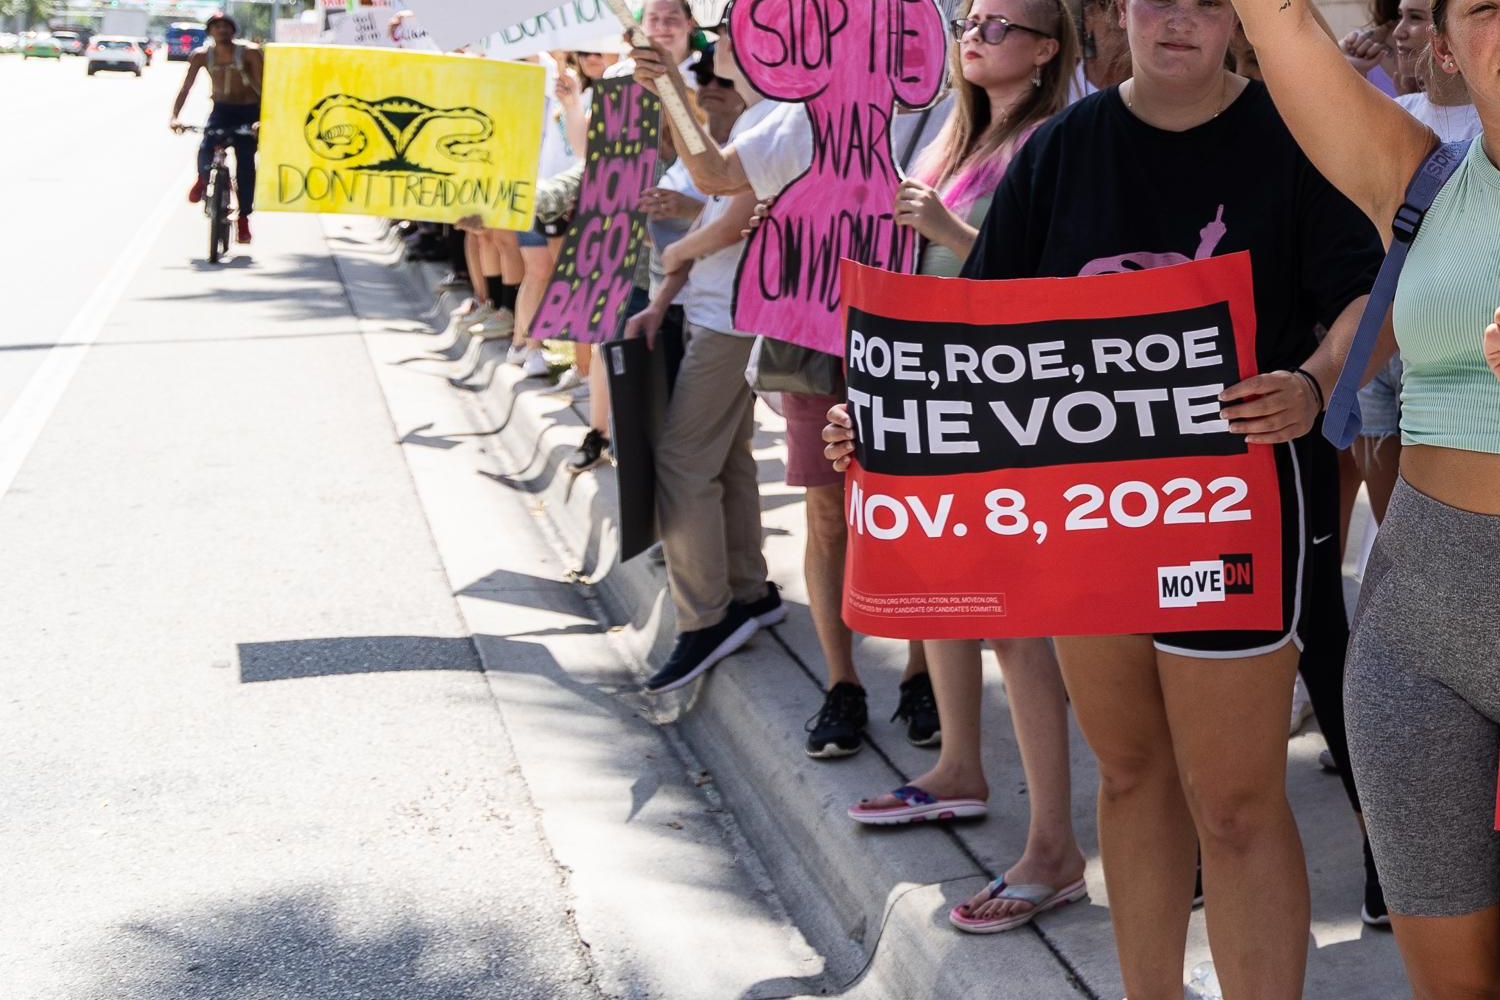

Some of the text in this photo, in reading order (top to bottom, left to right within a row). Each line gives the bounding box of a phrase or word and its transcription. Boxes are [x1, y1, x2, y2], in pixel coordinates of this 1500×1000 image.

[603, 82, 645, 142] WE
[813, 102, 890, 185] WAR
[385, 174, 457, 209] TREAD
[453, 176, 489, 206] ON
[491, 176, 533, 215] ME
[575, 211, 631, 278] GO
[758, 213, 807, 302] ON
[530, 274, 633, 344] BACK
[849, 326, 1223, 390] ROE, ROE, ROE
[847, 383, 1230, 454] THE VOTE
[848, 476, 1252, 545] NOV. 8, 2022
[899, 596, 927, 604] POLITICAL
[926, 605, 934, 613] OR
[1162, 562, 1251, 599] MOVEON
